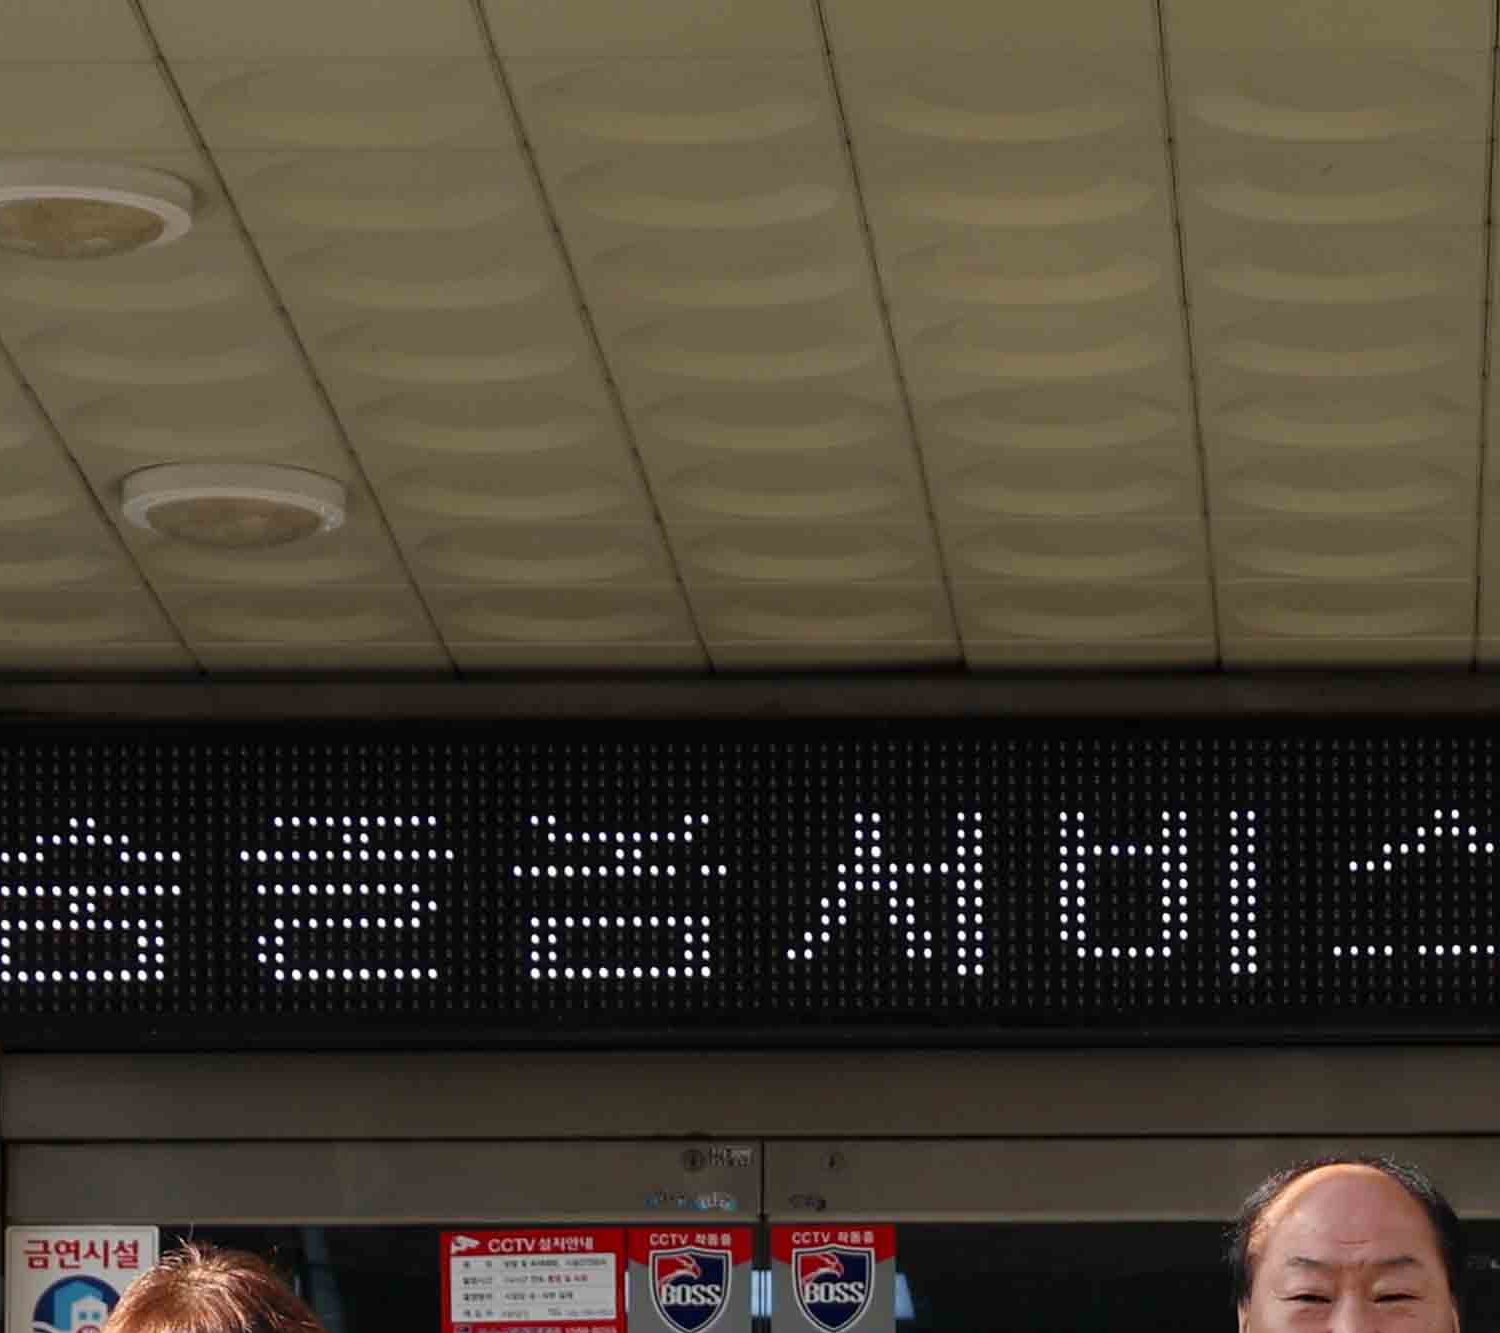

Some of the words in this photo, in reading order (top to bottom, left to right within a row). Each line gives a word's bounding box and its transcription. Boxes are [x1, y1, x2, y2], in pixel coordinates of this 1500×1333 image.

[487, 1237, 536, 1254] CCTV
[649, 1232, 689, 1246] CCTV
[791, 1230, 831, 1245] CCTV
[23, 1239, 141, 1270] 금연시설
[661, 1284, 722, 1307] BOSS
[804, 1281, 866, 1305] BOSS
